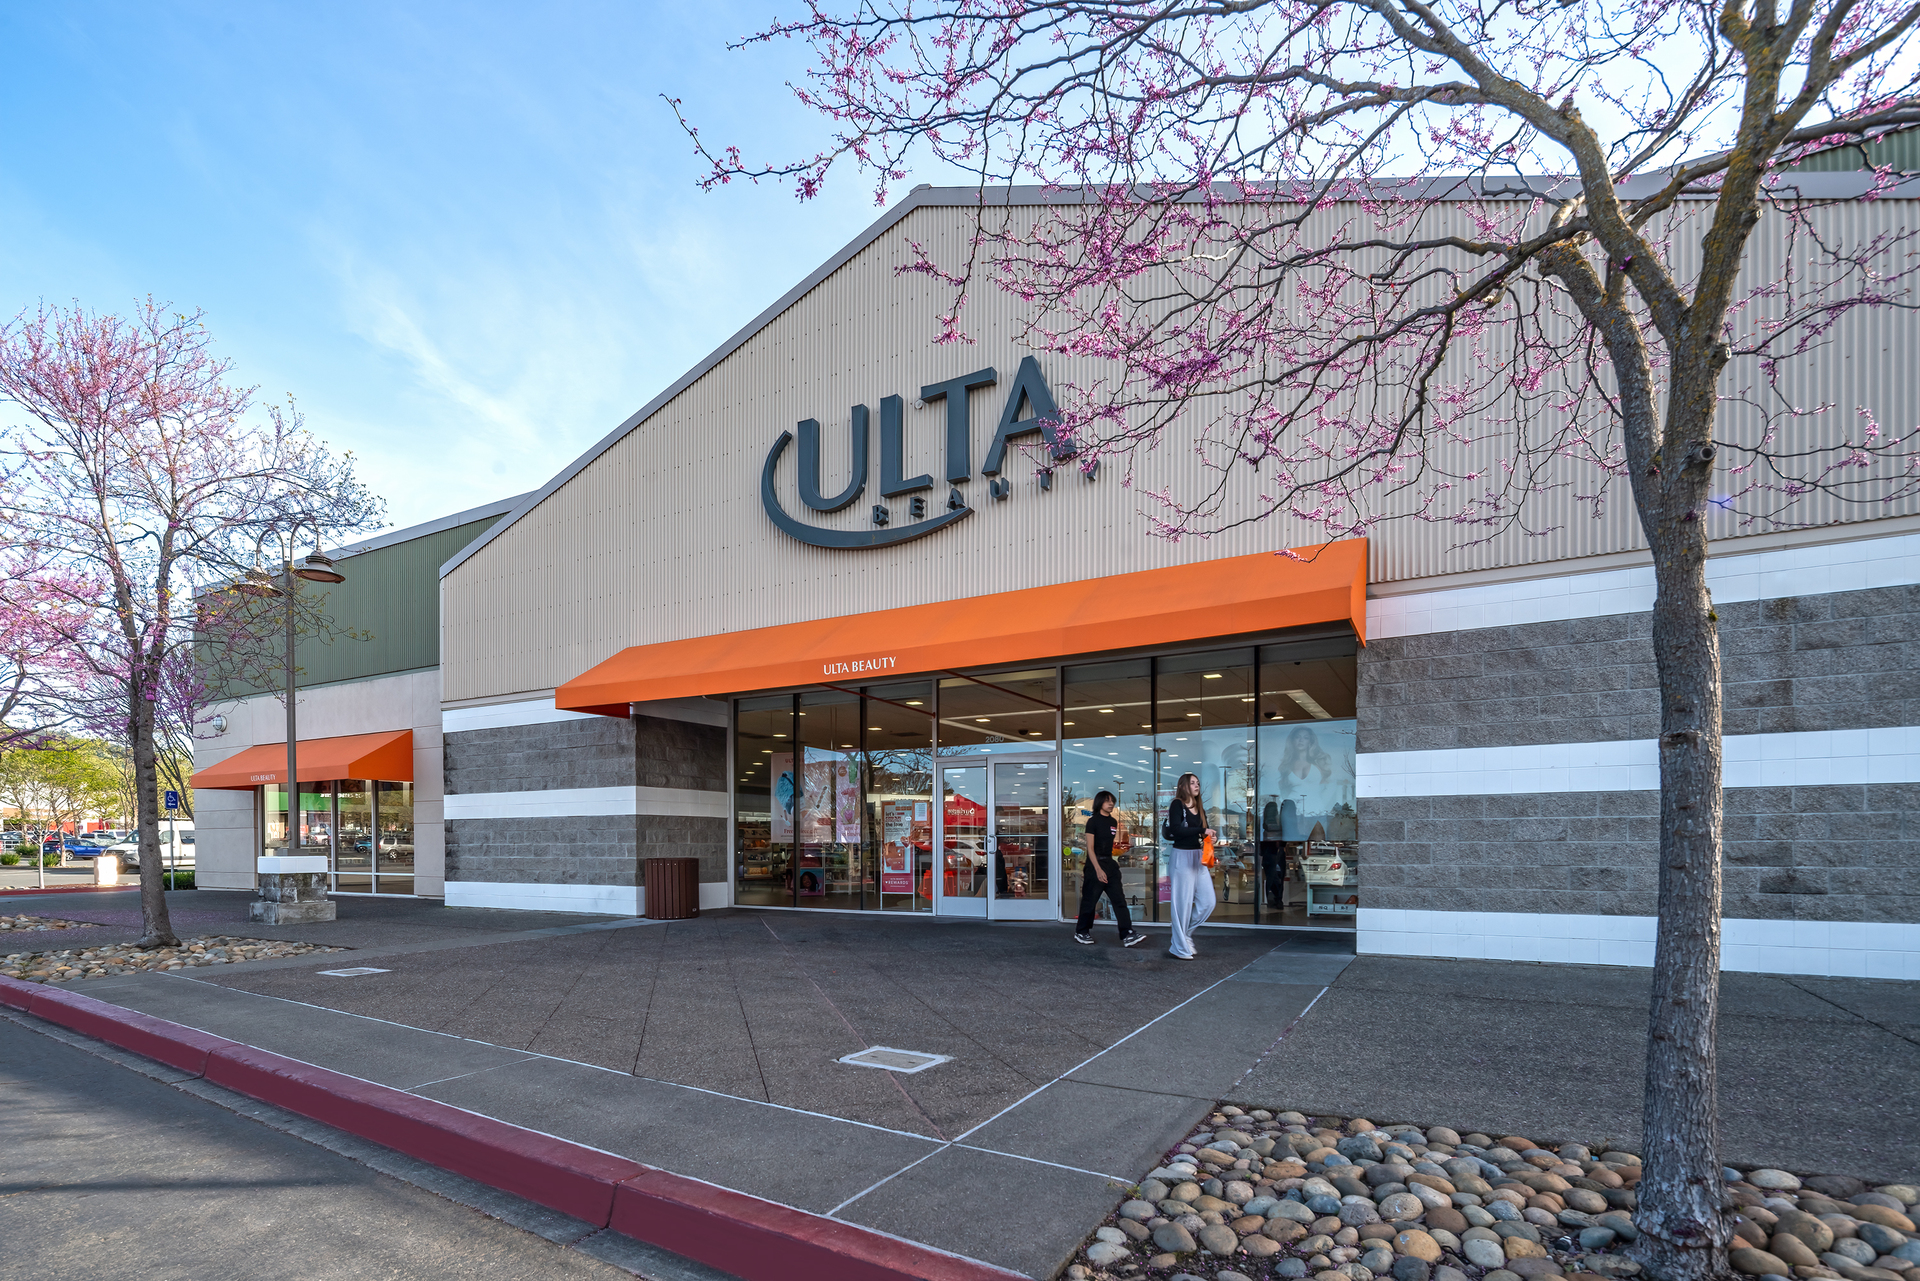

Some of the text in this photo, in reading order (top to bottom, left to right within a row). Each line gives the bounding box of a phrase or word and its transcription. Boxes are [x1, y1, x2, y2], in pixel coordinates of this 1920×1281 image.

[797, 355, 1079, 513] ULTA
[872, 457, 1101, 527] BEAUTY
[823, 656, 897, 676] ULTA BEAUTY
[985, 735, 1005, 744] 2080
